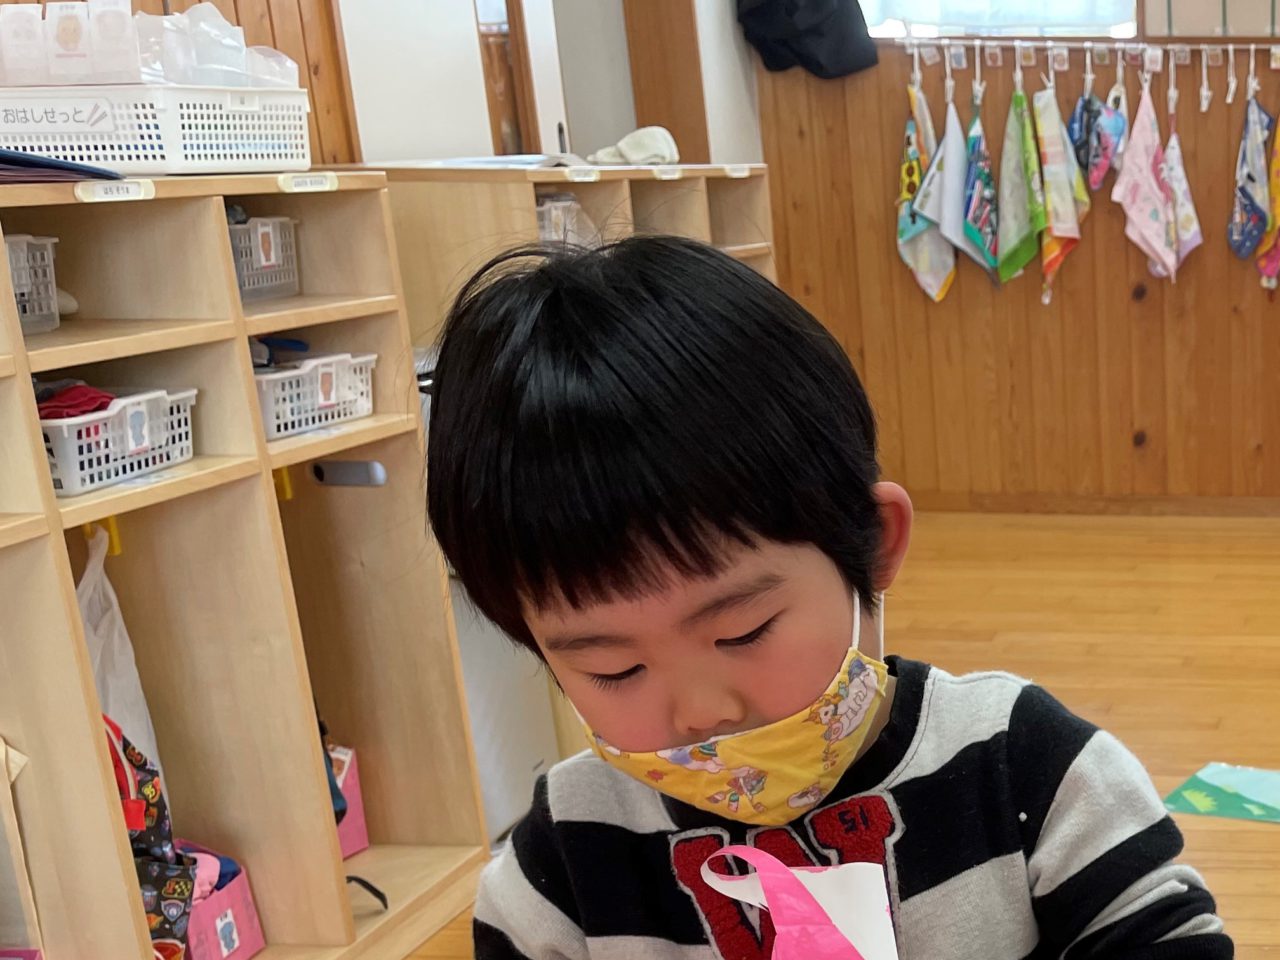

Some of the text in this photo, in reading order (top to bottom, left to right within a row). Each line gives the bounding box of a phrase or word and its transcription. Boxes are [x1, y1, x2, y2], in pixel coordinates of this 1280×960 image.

[2, 107, 86, 124] おはしせっと
